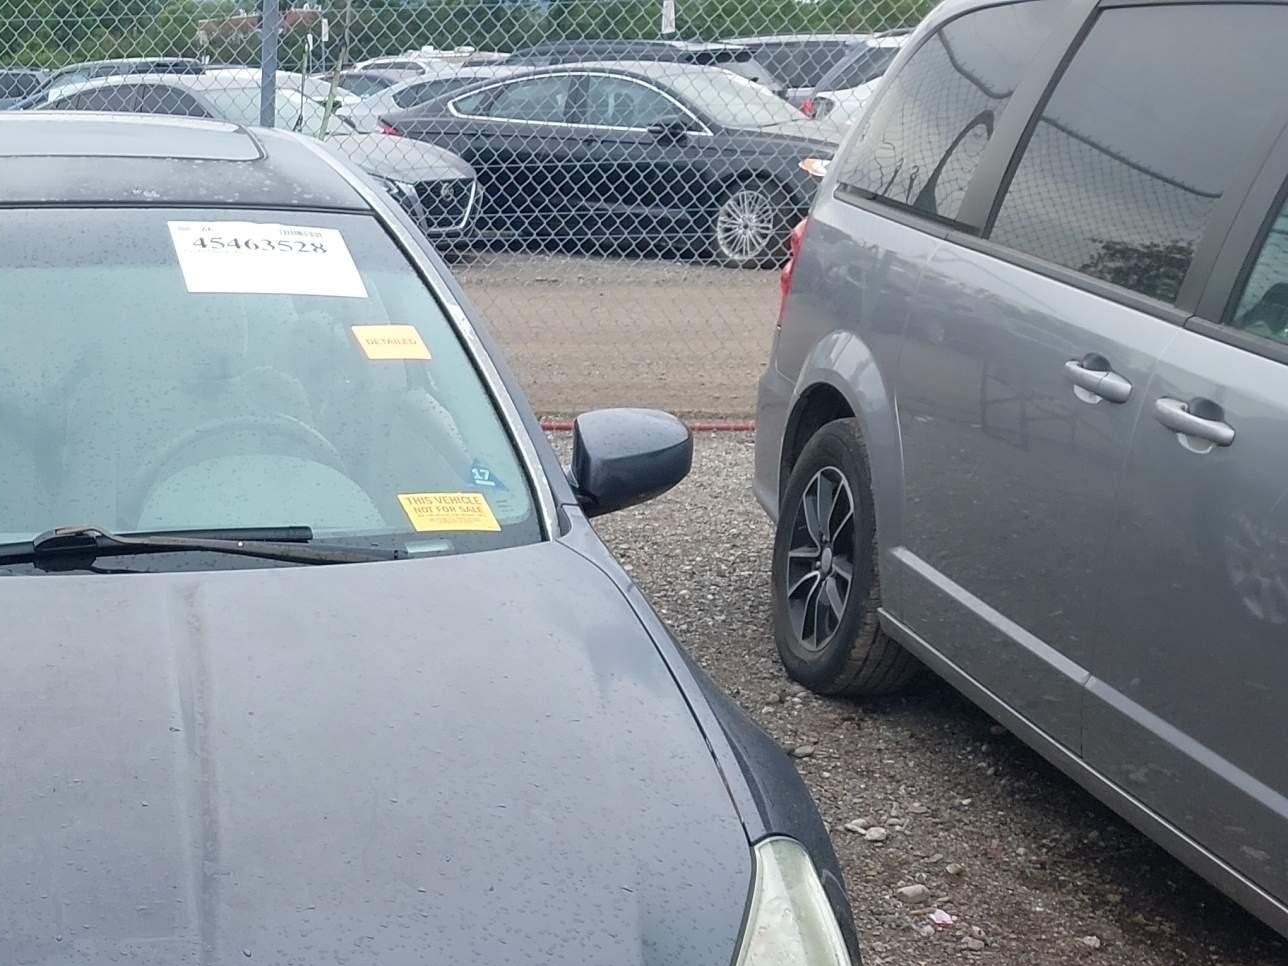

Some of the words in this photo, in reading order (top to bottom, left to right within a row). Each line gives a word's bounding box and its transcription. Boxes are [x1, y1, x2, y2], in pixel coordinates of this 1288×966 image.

[193, 237, 328, 254] 45463528
[472, 468, 489, 480] 17
[406, 495, 433, 505] THIS
[435, 495, 482, 505] VEHICLE
[413, 505, 433, 513] NOT
[436, 505, 457, 513] FOR
[459, 505, 484, 513] SALE
